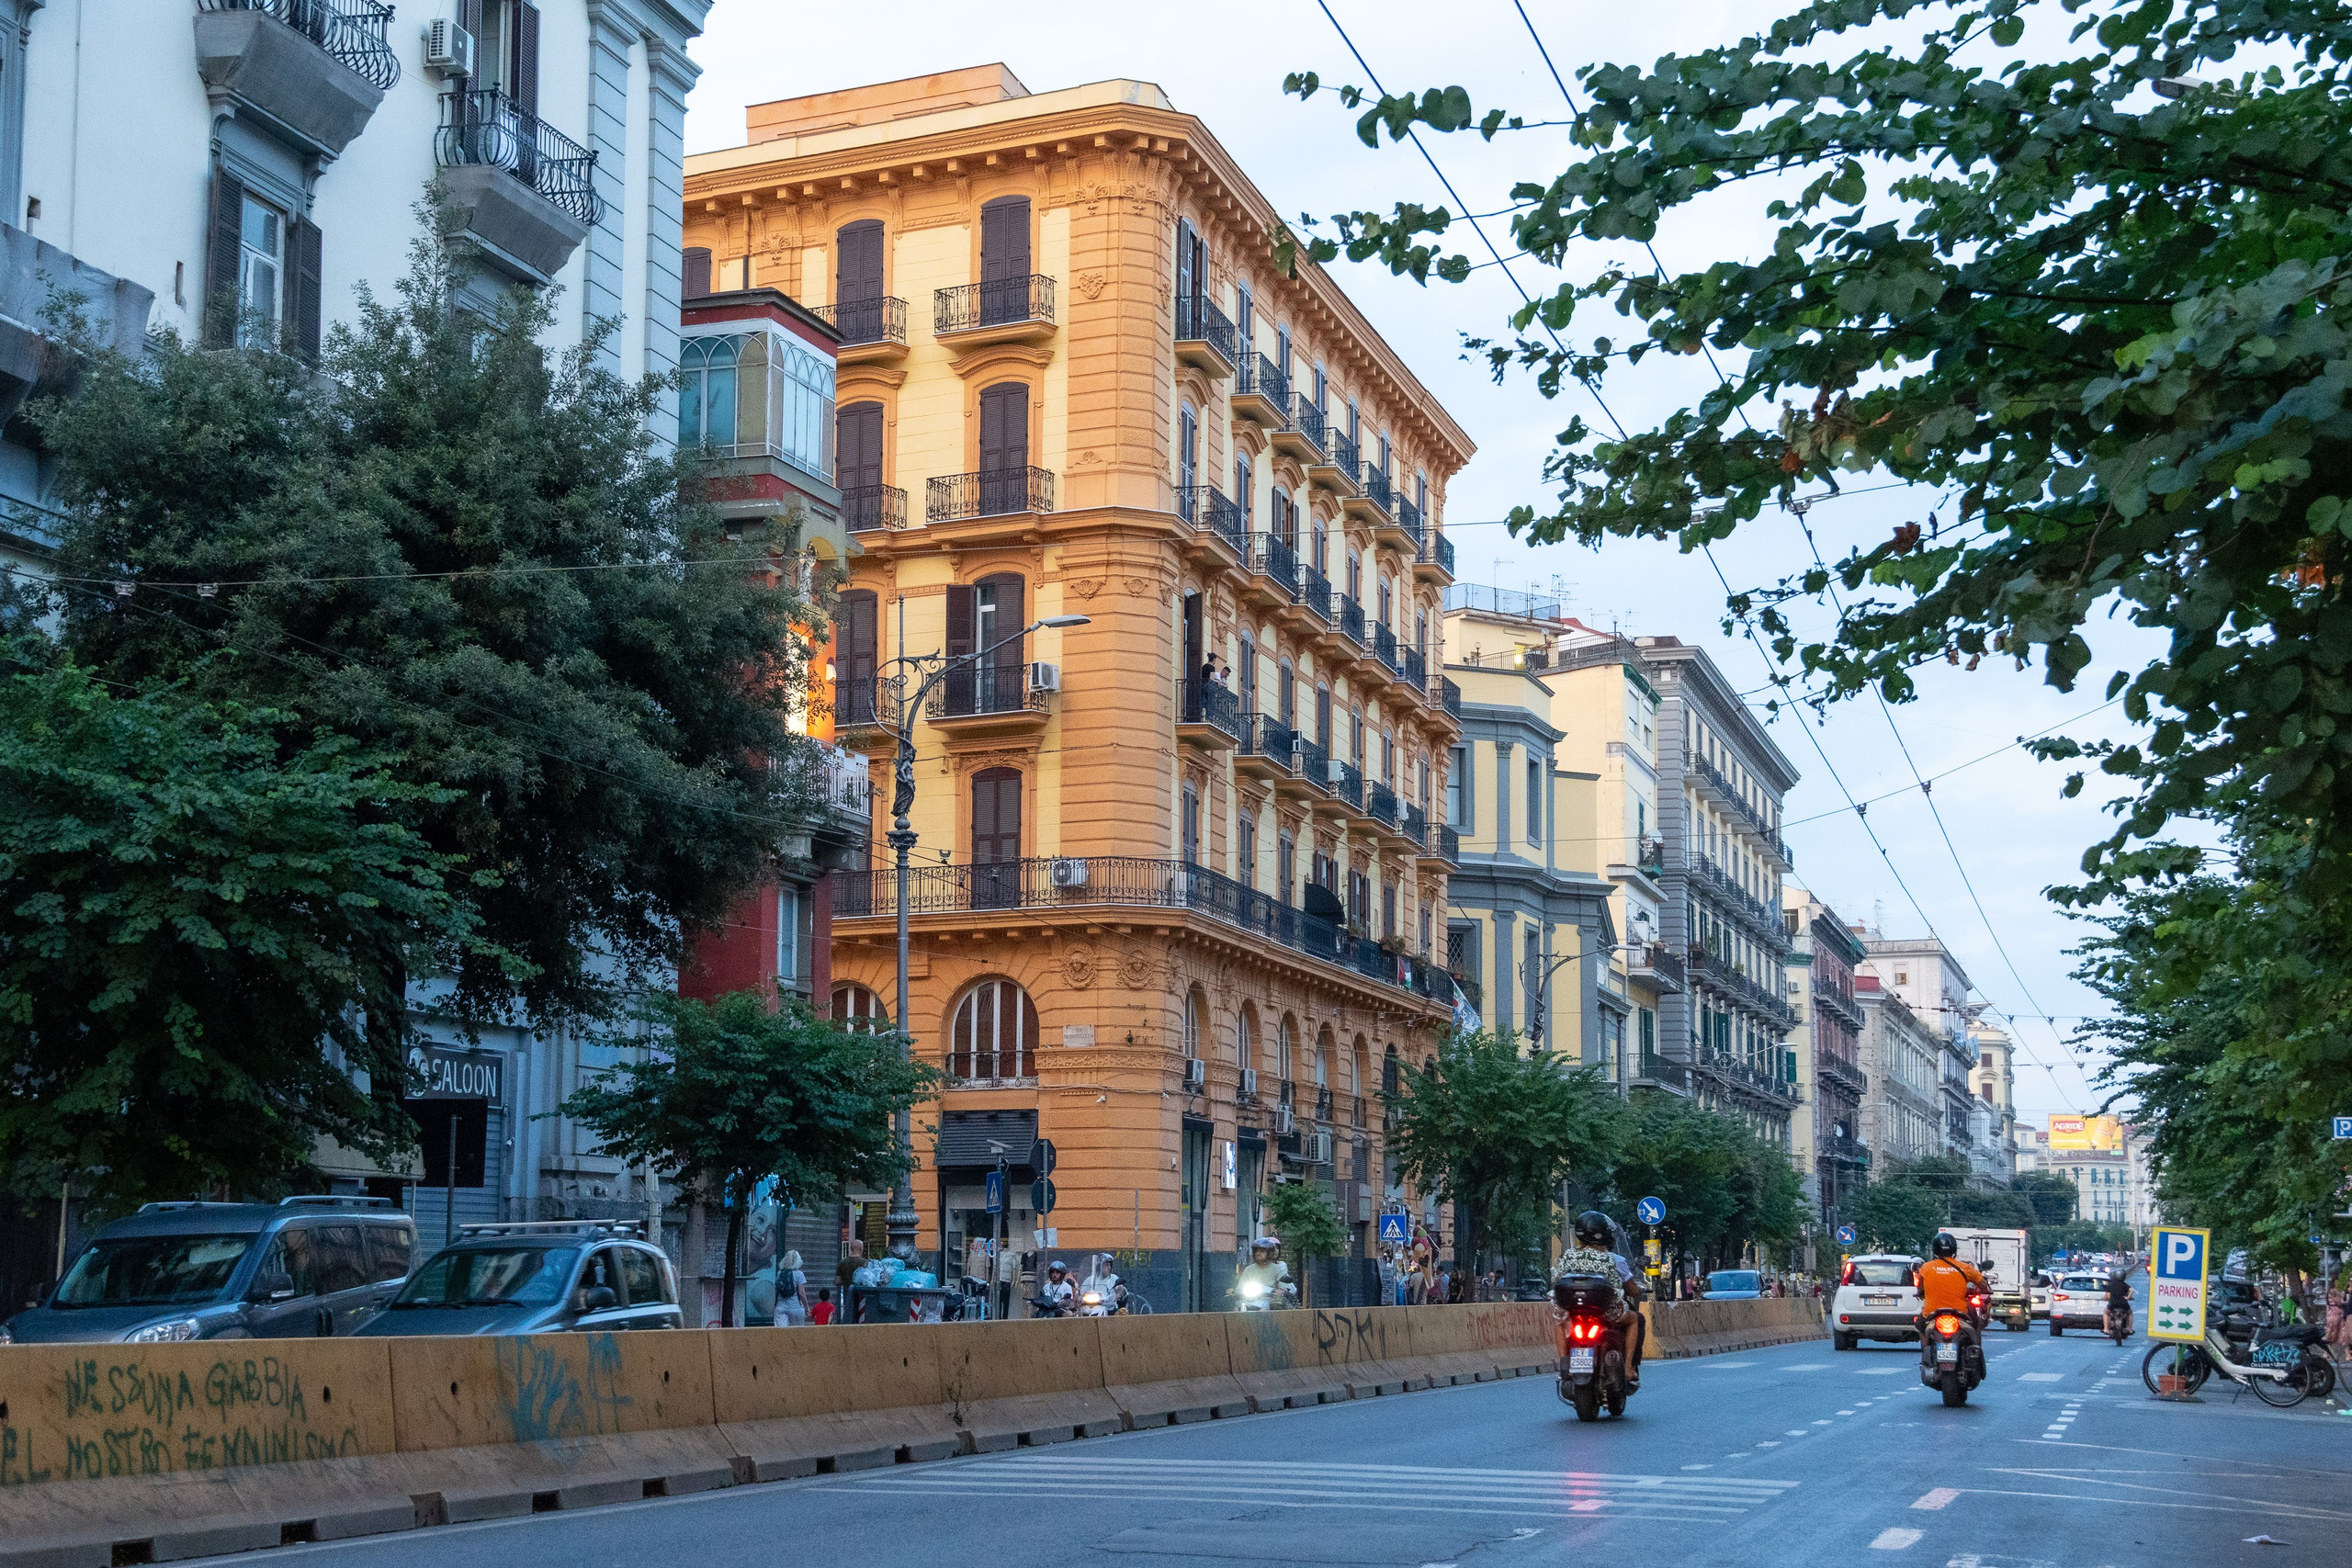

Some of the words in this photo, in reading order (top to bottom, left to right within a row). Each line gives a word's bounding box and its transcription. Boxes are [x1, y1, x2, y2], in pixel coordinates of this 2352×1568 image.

[432, 1058, 497, 1098] SALOON
[2340, 1121, 2352, 1135] P
[2166, 1234, 2196, 1275] P
[2158, 1284, 2199, 1300] PARKING
[205, 1357, 307, 1424] GABBIA
